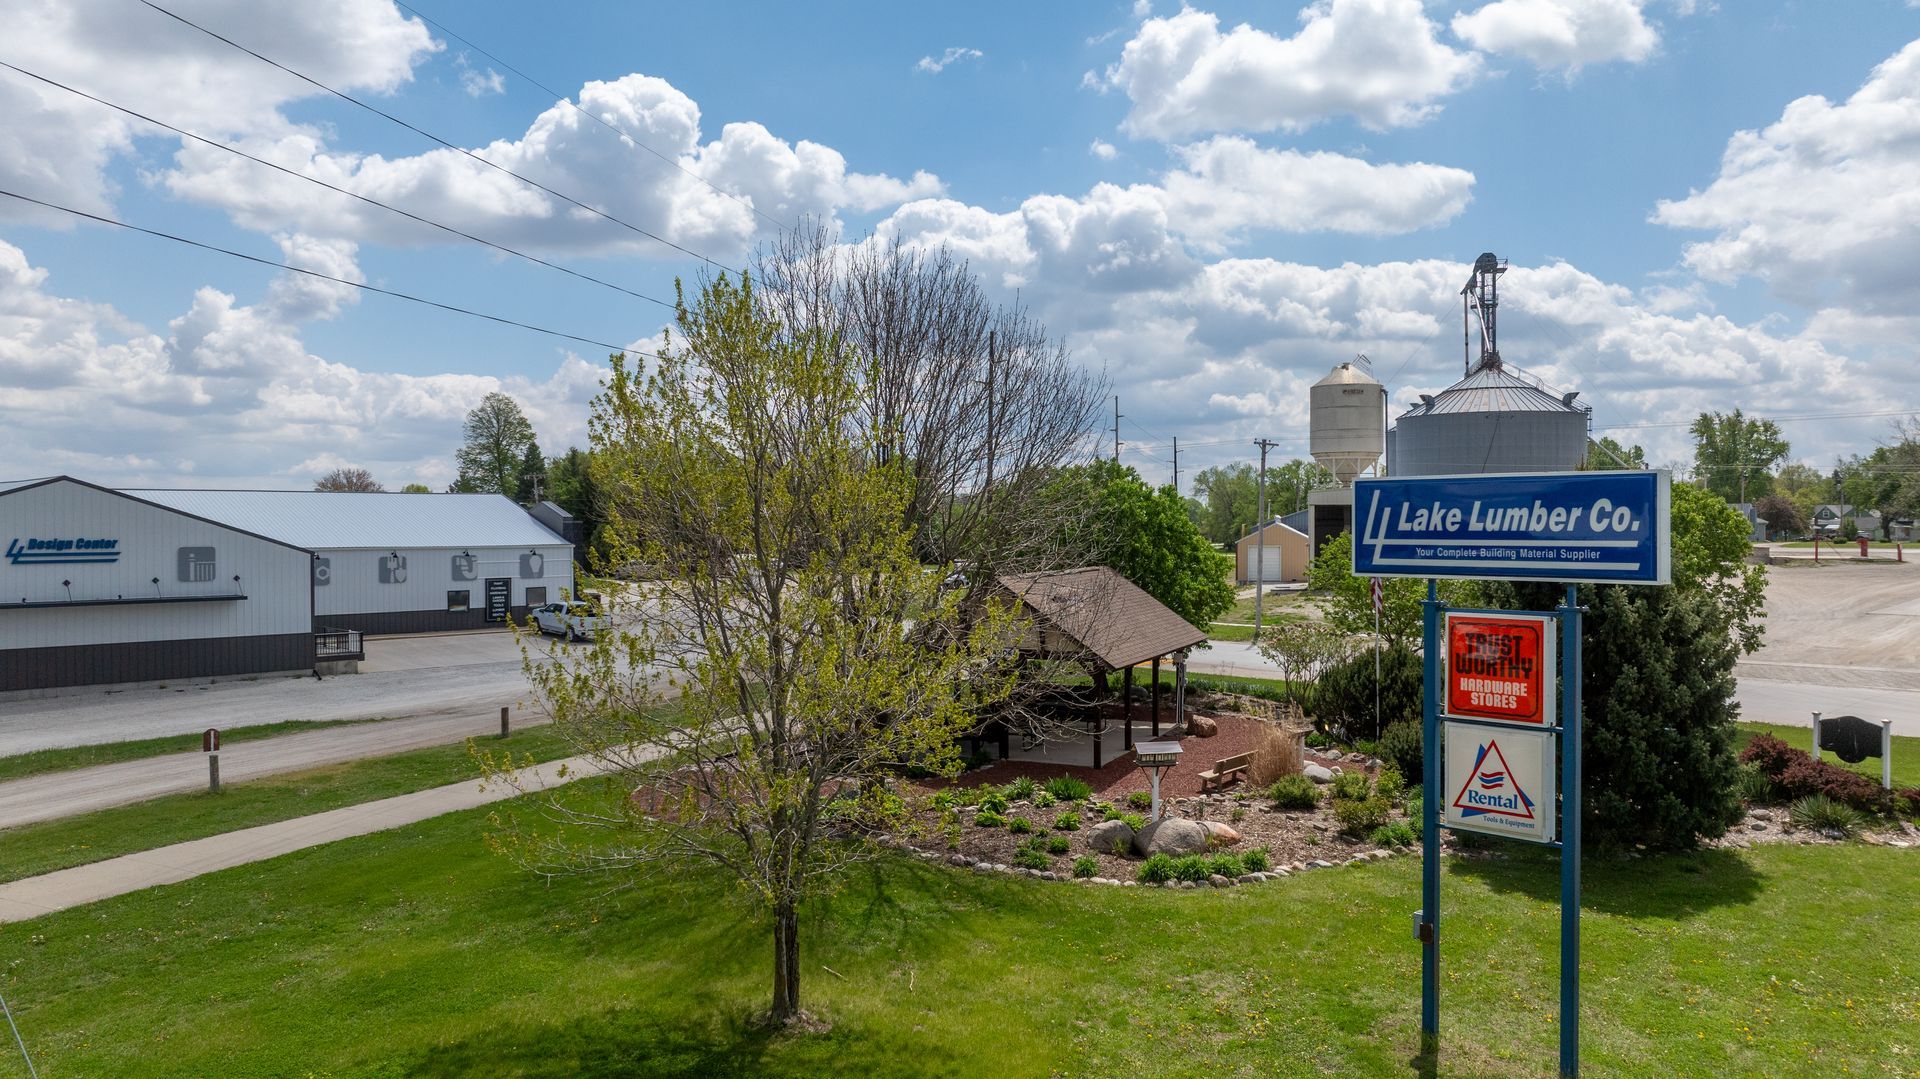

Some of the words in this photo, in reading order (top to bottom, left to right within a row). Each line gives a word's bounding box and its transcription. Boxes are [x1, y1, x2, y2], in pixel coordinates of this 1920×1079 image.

[1398, 501, 1461, 531] Lake
[1468, 500, 1581, 532] Lumber
[1589, 498, 1640, 532] Co.
[27, 538, 73, 551] Design
[75, 537, 118, 550] Center
[1415, 547, 1434, 556] Your
[1437, 547, 1477, 558] Complete
[1480, 548, 1516, 560] Building
[1520, 549, 1557, 558] Material
[1560, 549, 1601, 561] Supplier
[1455, 652, 1533, 679] WORTHY
[1460, 677, 1528, 697] HARDWARE
[1470, 691, 1517, 709] STORES
[1468, 789, 1518, 810] Rental
[1483, 815, 1498, 824] Tools
[1505, 818, 1535, 829] Equipment
